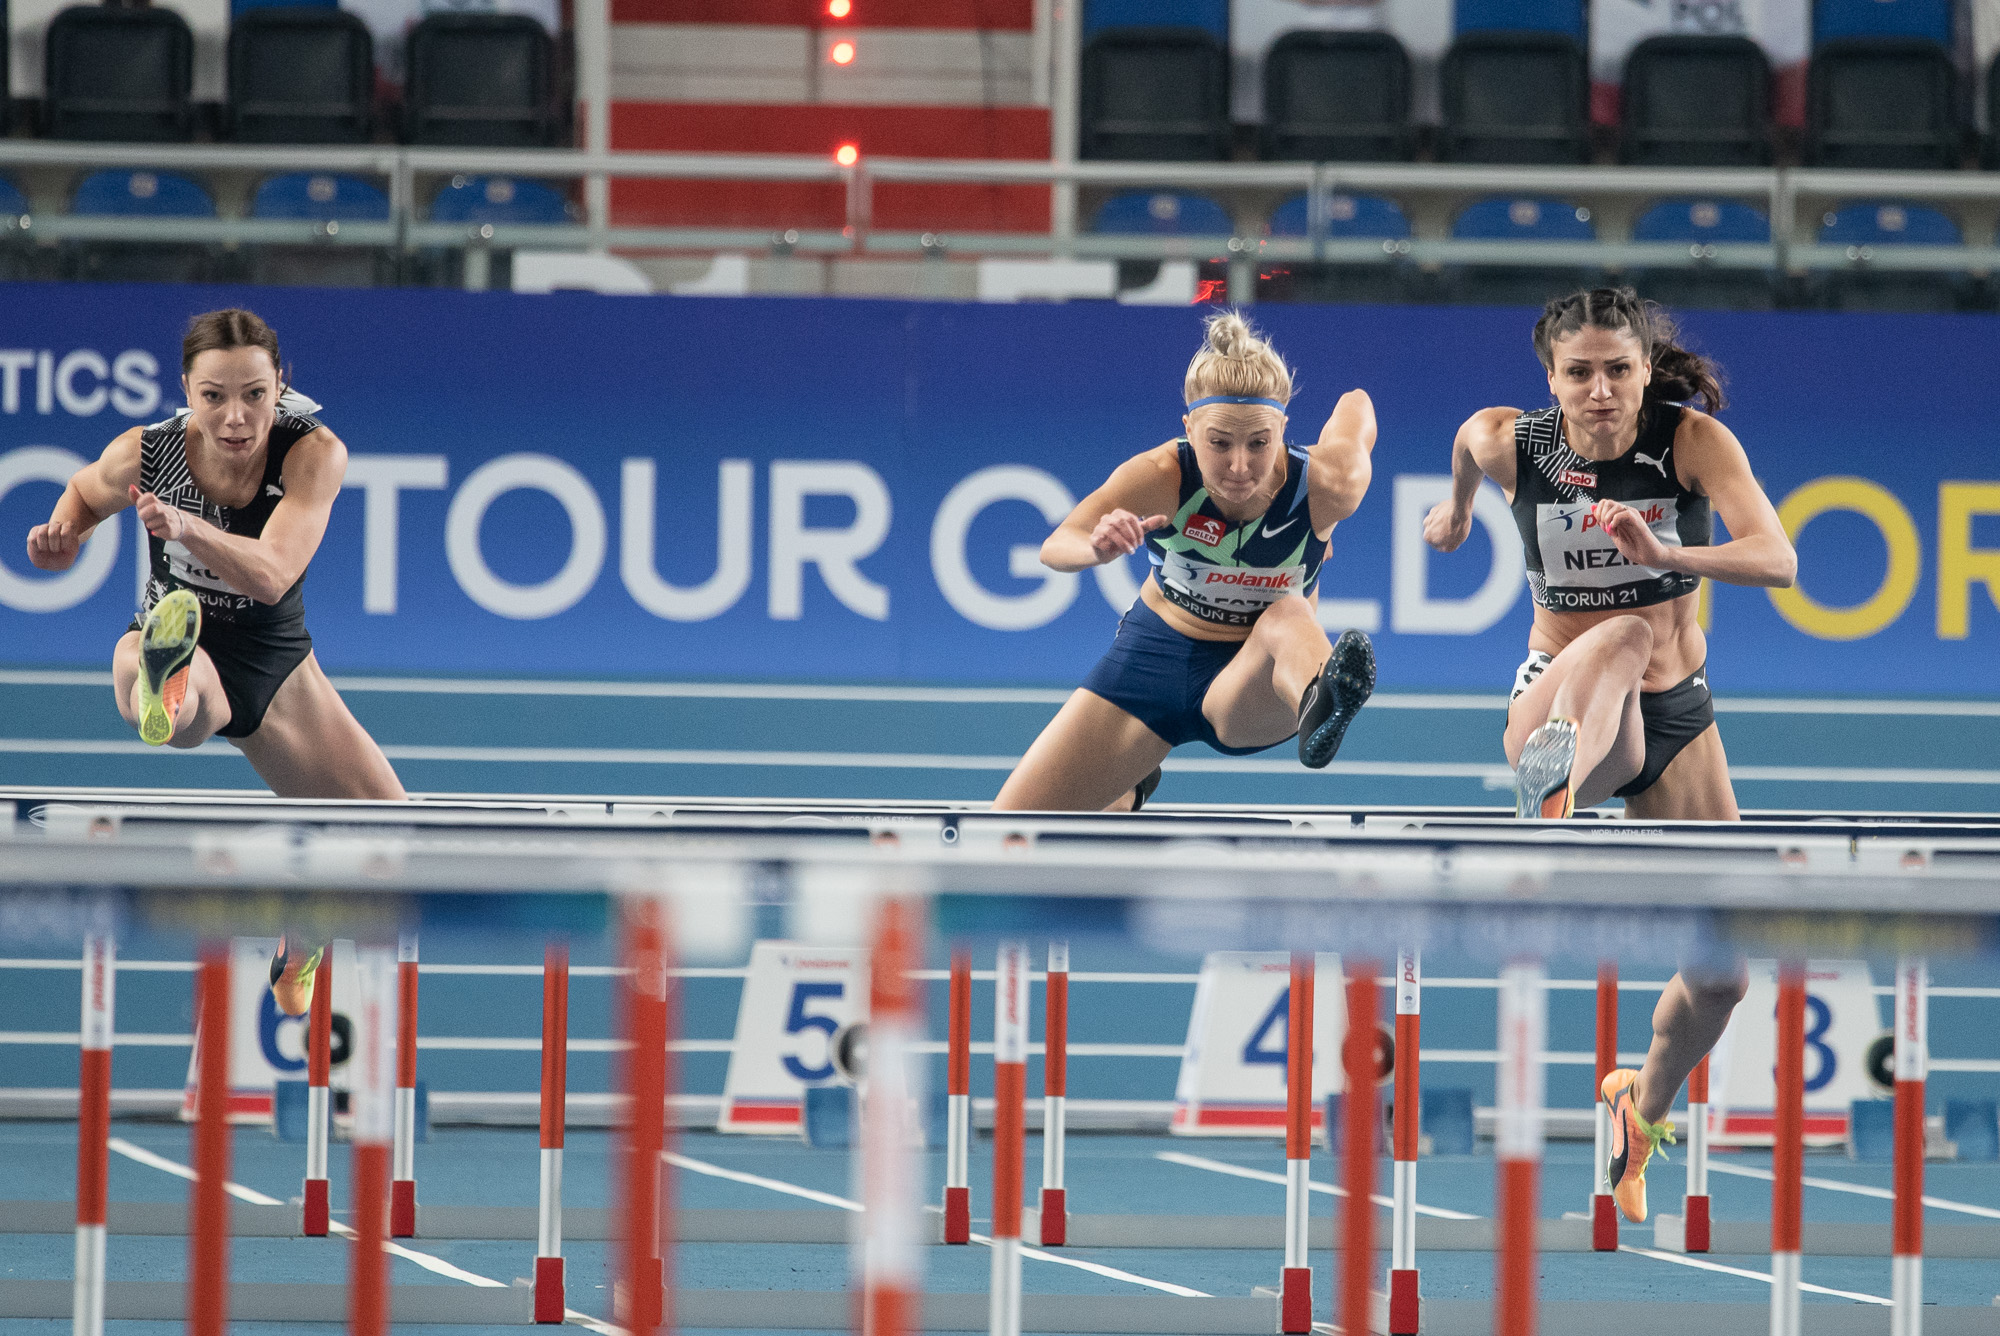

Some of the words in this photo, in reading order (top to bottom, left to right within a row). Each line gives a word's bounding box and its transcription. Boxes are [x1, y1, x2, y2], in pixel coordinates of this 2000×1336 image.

[0, 350, 160, 418] TICS
[1565, 472, 1592, 485] helo
[1188, 529, 1216, 542] ORLEN
[340, 452, 893, 622] TOUR
[930, 464, 1527, 635] GD
[1697, 475, 2000, 641] OR
[1563, 547, 1640, 570] NEZ
[1205, 572, 1293, 589] polanik
[236, 597, 254, 610] 21
[1554, 590, 1614, 607] TORUŃ
[1620, 588, 1638, 604] 21
[1229, 614, 1248, 624] 21
[1591, 828, 1619, 836] WORLD
[1620, 828, 1664, 837] ATHLETICS
[258, 980, 312, 1073] 6
[781, 982, 845, 1083] 5
[1242, 985, 1314, 1089] 4
